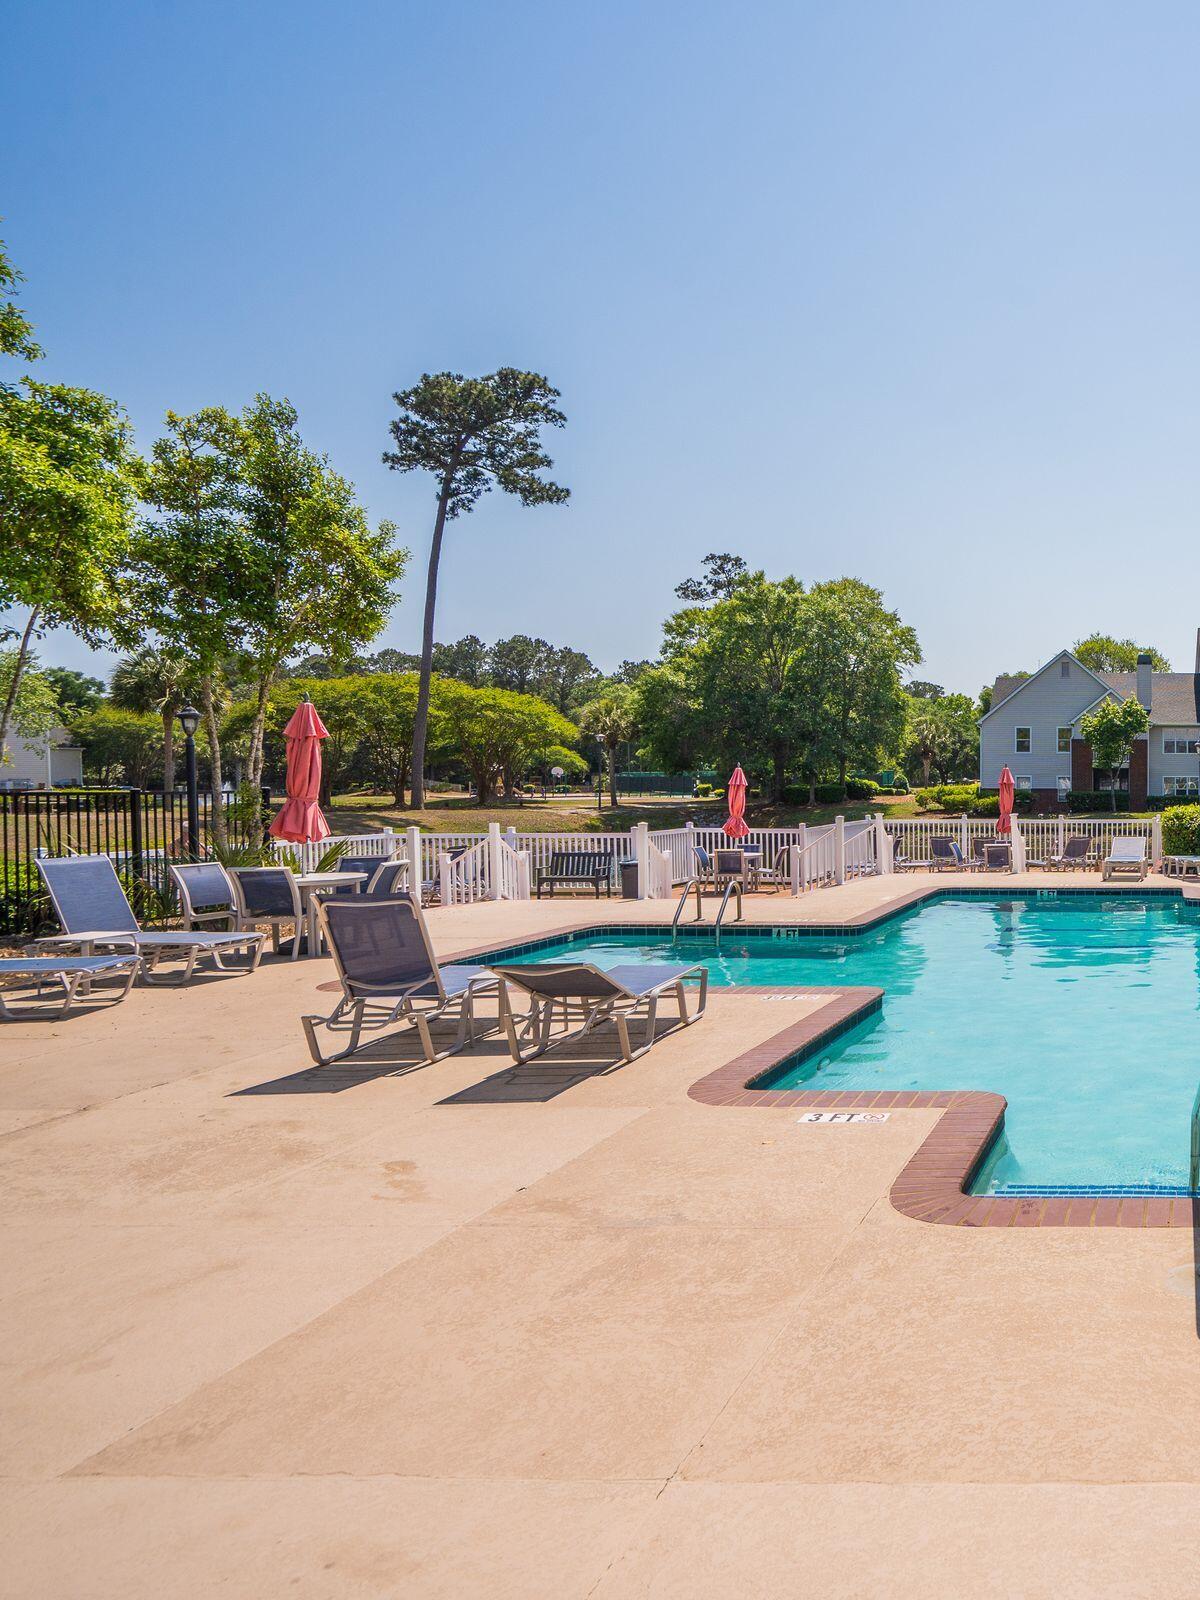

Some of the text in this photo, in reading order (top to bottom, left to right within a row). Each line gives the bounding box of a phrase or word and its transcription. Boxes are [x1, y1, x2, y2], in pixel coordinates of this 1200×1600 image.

[786, 929, 798, 937] FT
[807, 1113, 860, 1122] 3 FT
